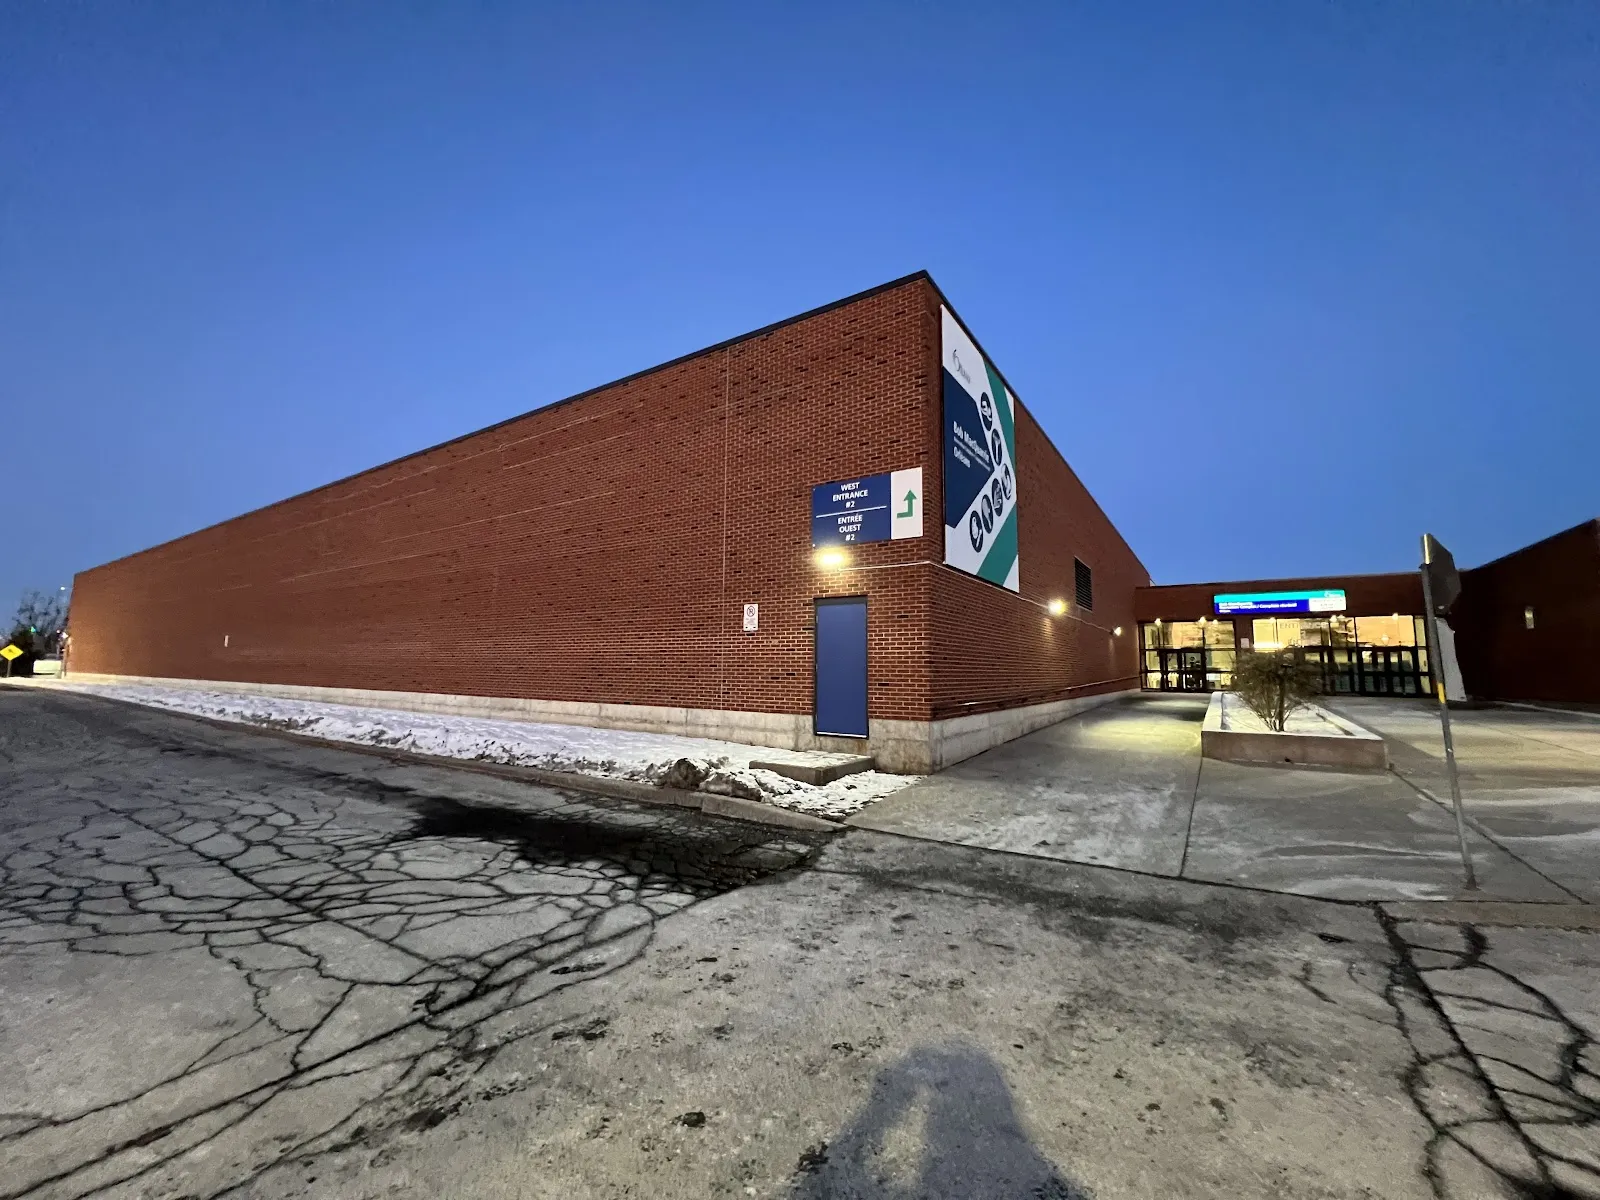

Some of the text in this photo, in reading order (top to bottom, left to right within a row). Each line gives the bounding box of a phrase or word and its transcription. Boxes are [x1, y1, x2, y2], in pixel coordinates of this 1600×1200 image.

[841, 482, 860, 491] WEST
[833, 490, 868, 502] ENTRANCE
[838, 514, 863, 524] ENTRÉE
[839, 524, 861, 533] OUEST
